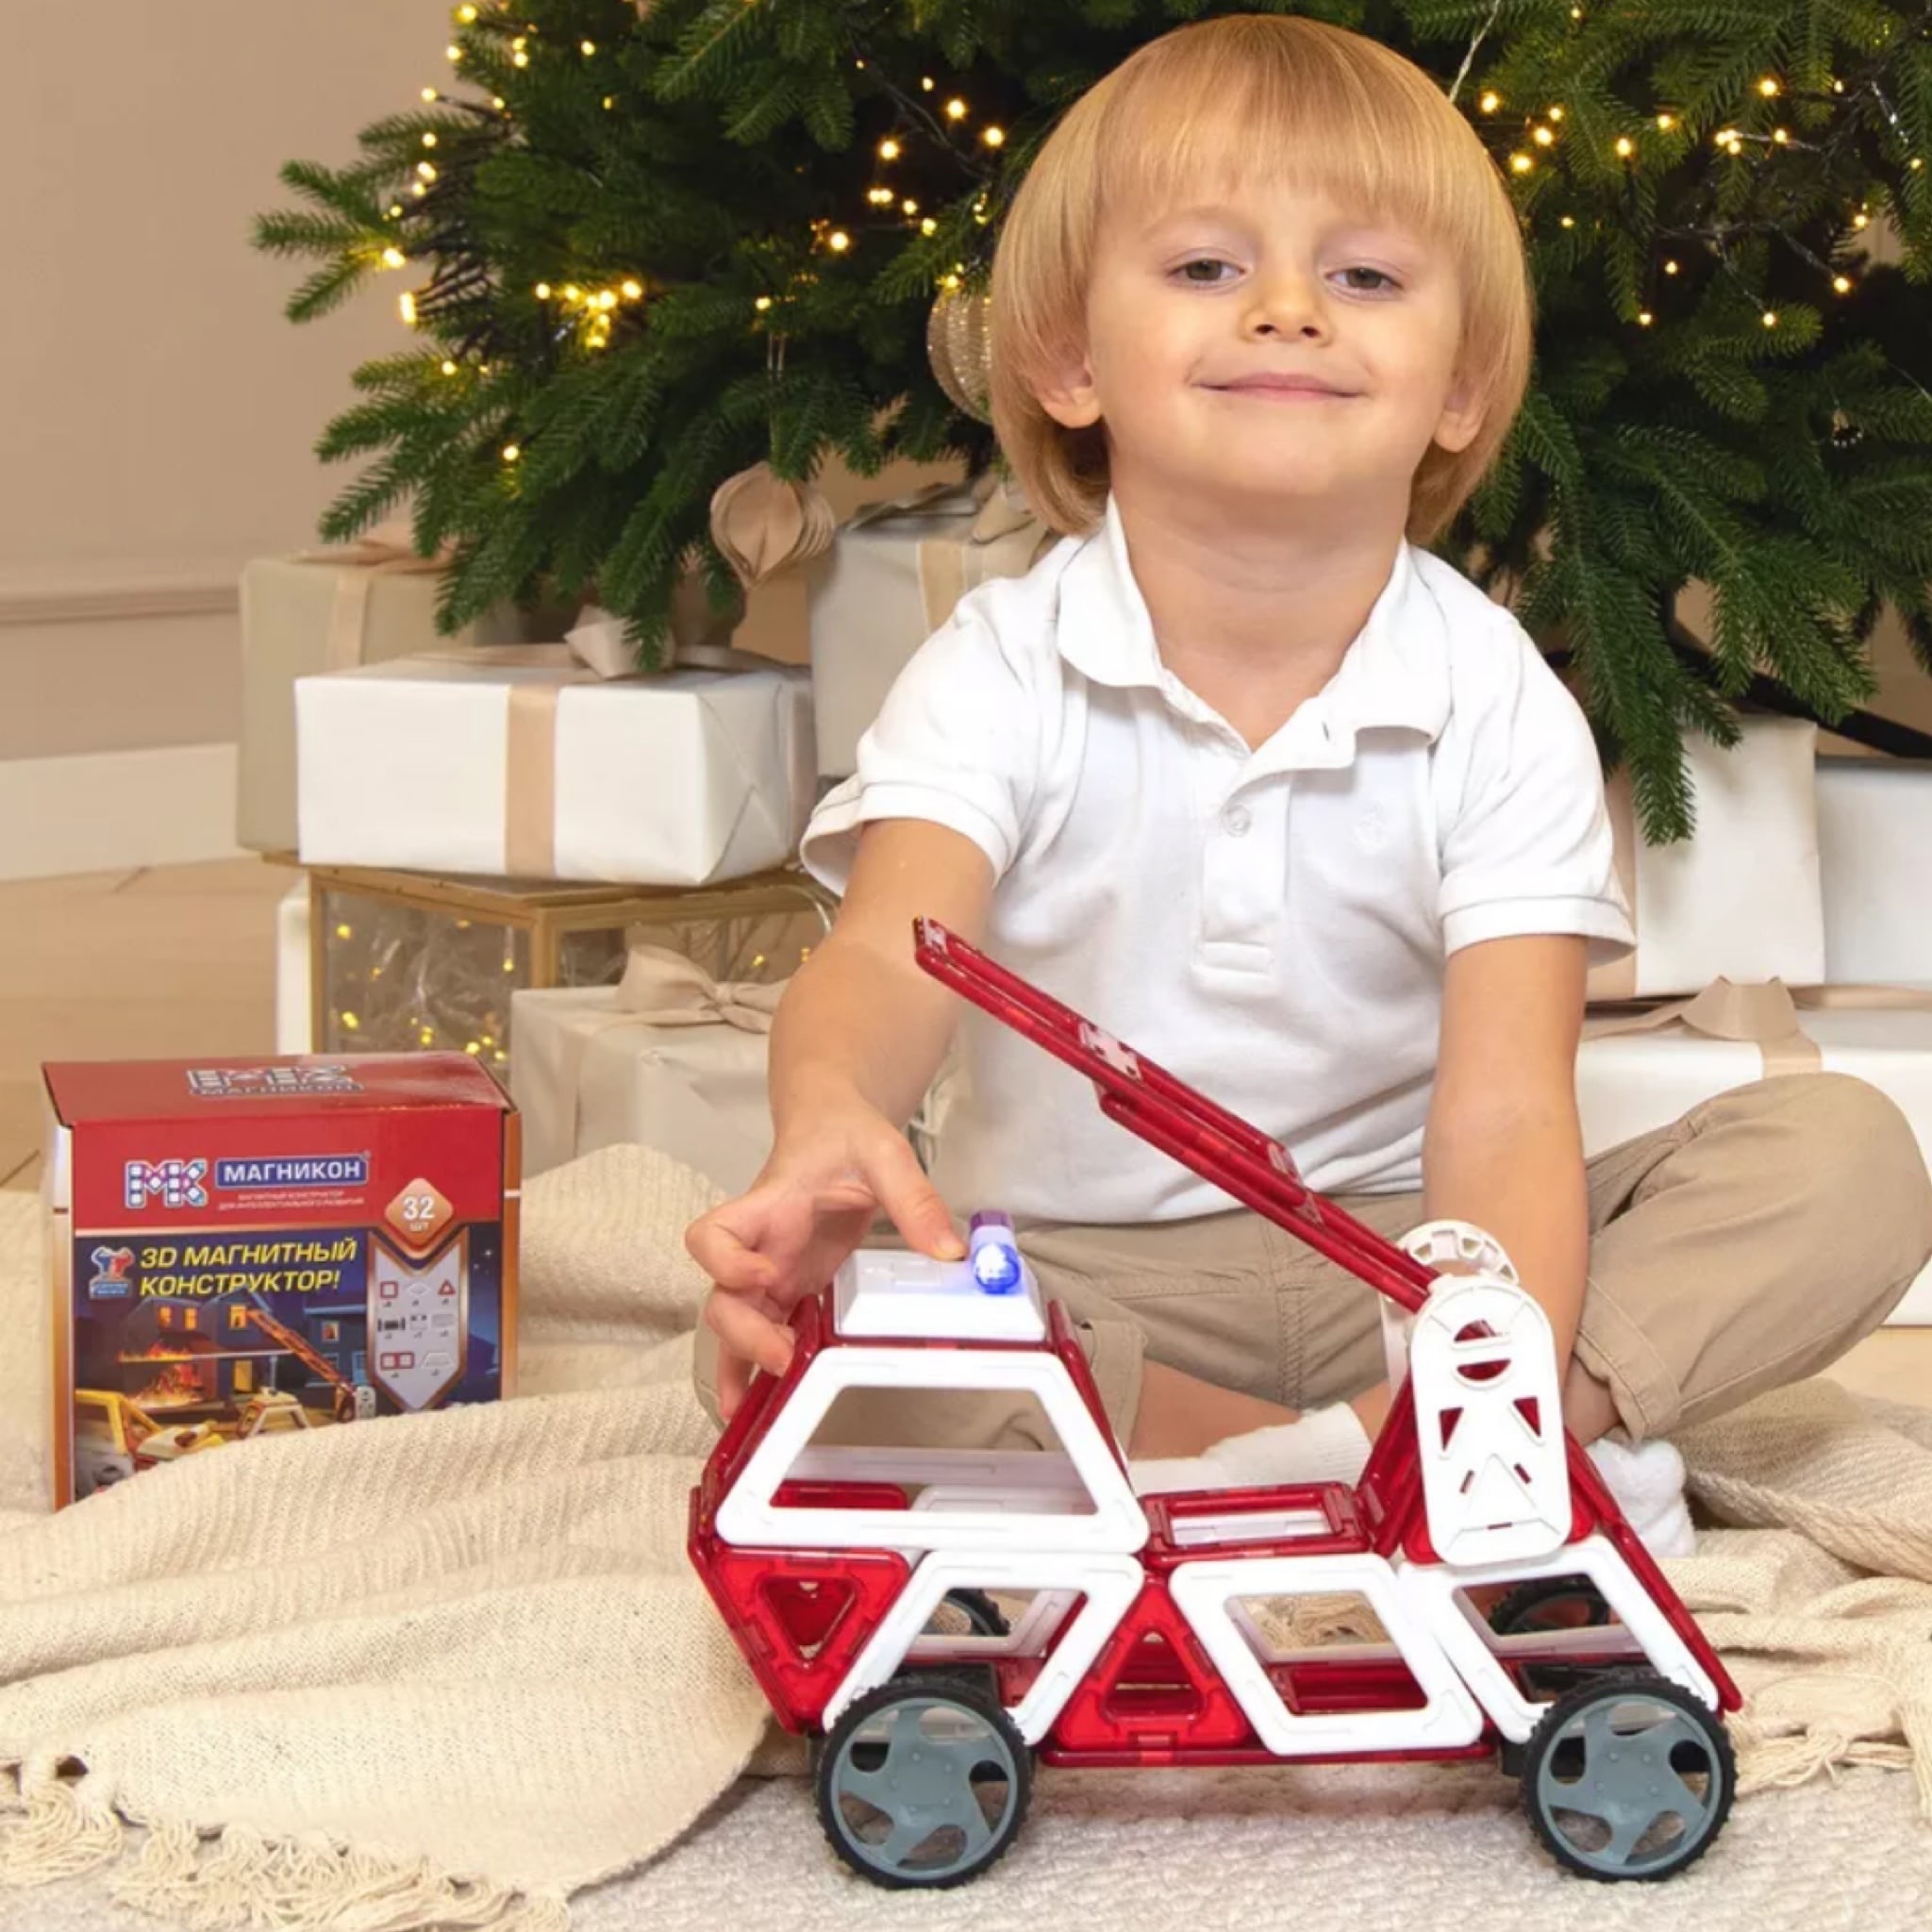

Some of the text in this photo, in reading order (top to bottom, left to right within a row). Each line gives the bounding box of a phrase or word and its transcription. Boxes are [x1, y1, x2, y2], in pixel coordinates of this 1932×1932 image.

[224, 1159, 361, 1183] МАГНИКОН
[403, 1195, 436, 1221] 32
[140, 1237, 358, 1269] 3D МАГНИТНЫЙ
[139, 1270, 341, 1297] КОНСТРУКТОР!
